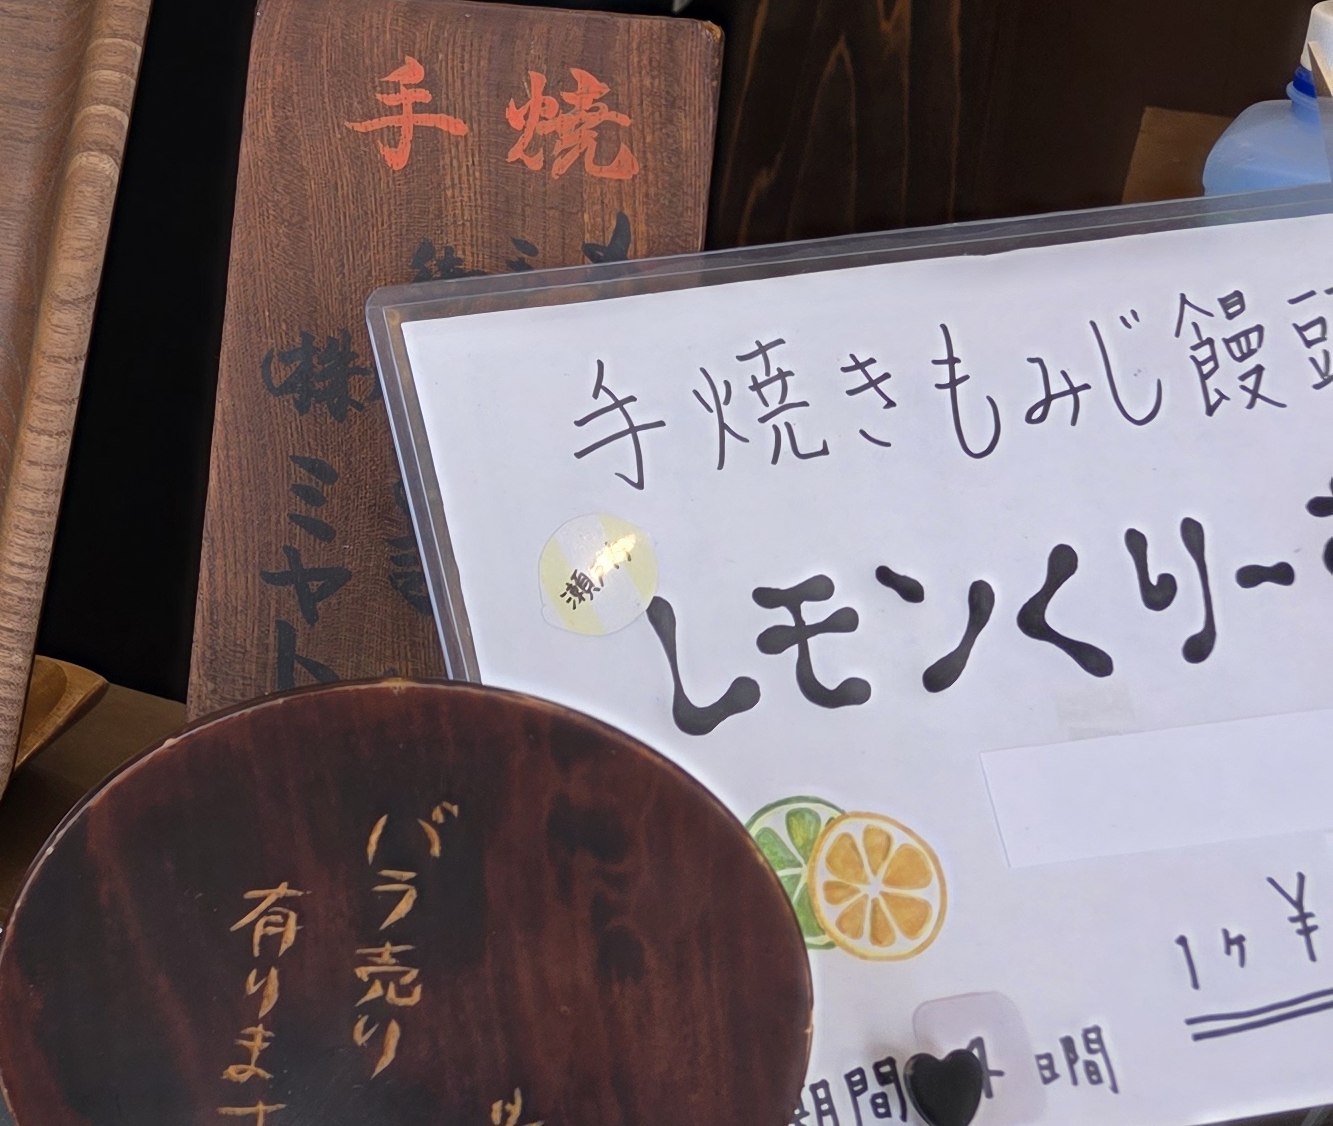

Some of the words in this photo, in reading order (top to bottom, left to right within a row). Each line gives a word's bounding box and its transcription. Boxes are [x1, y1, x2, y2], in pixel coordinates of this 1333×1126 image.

[345, 55, 640, 180] 手焼
[644, 476, 1333, 735] レモンくりー
[217, 880, 313, 1126] 有りま
[352, 800, 459, 1081] バラ売り
